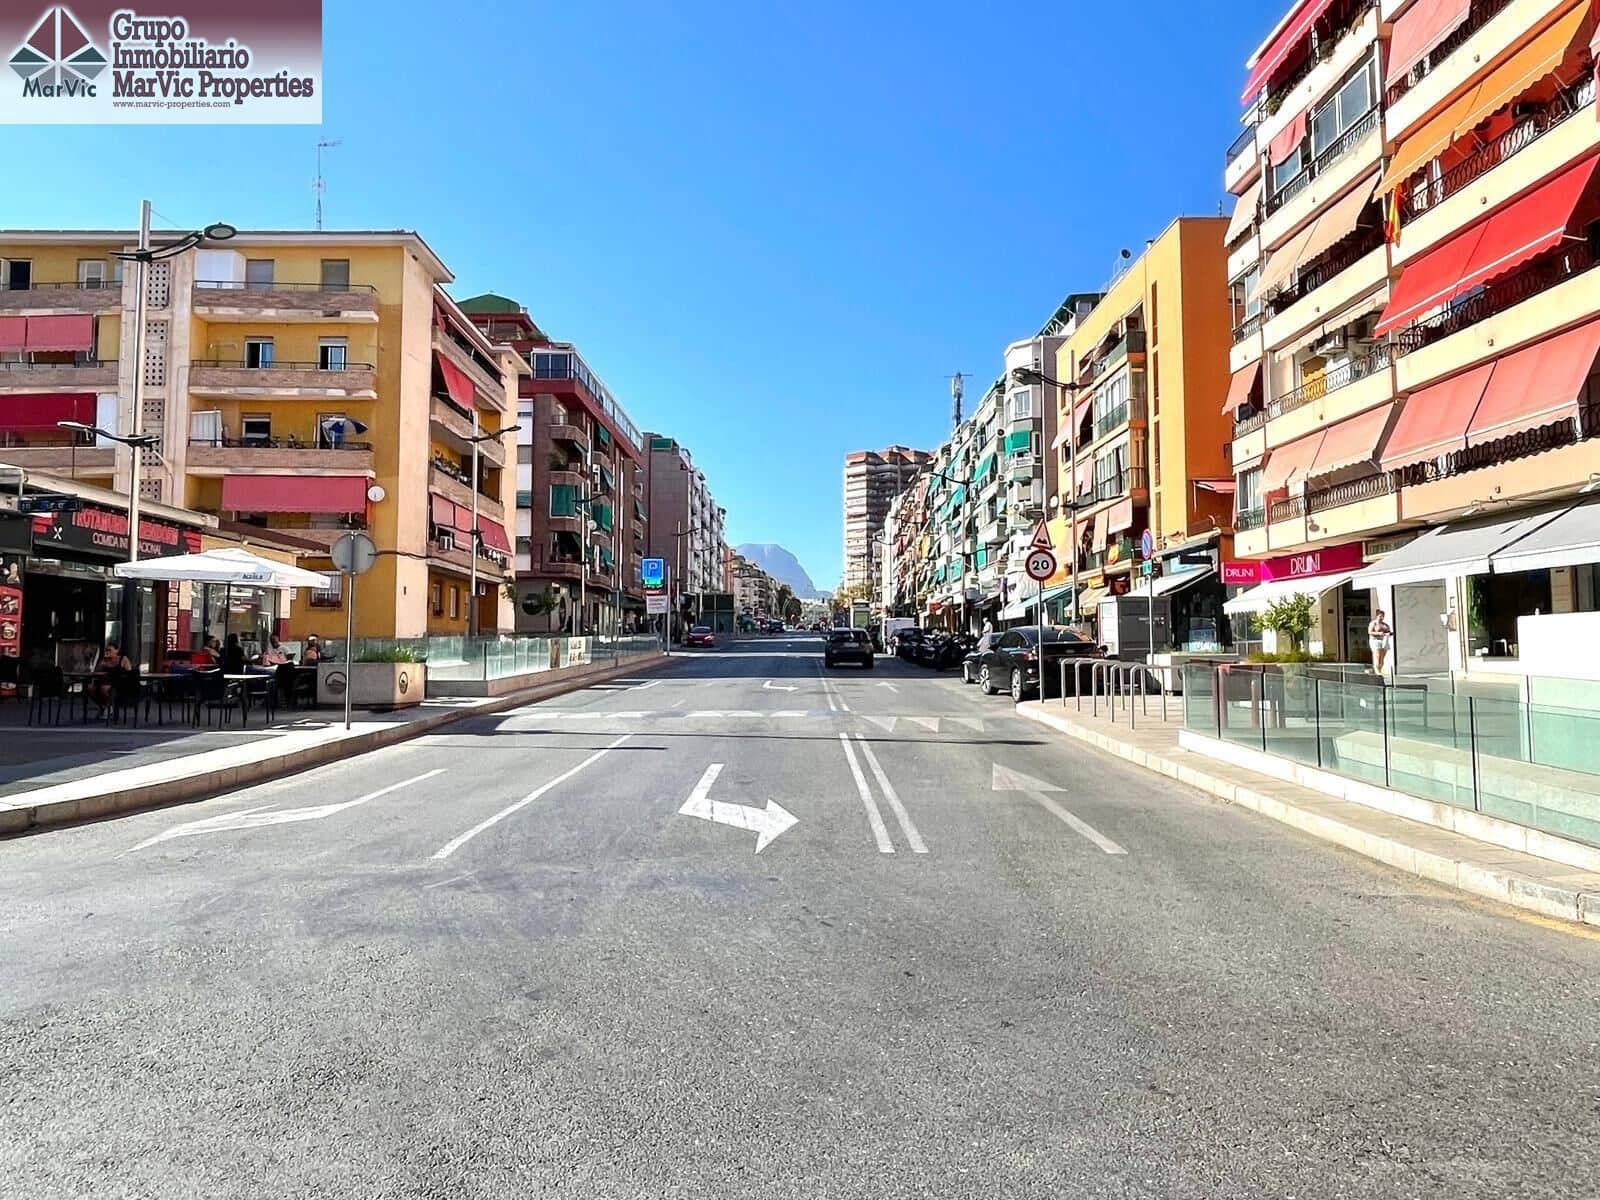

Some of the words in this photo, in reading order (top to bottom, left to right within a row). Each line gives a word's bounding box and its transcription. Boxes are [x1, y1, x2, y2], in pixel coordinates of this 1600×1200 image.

[1032, 560, 1050, 571] 20
[1290, 552, 1321, 574] DRUNI
[1225, 567, 1254, 577] DRUNI
